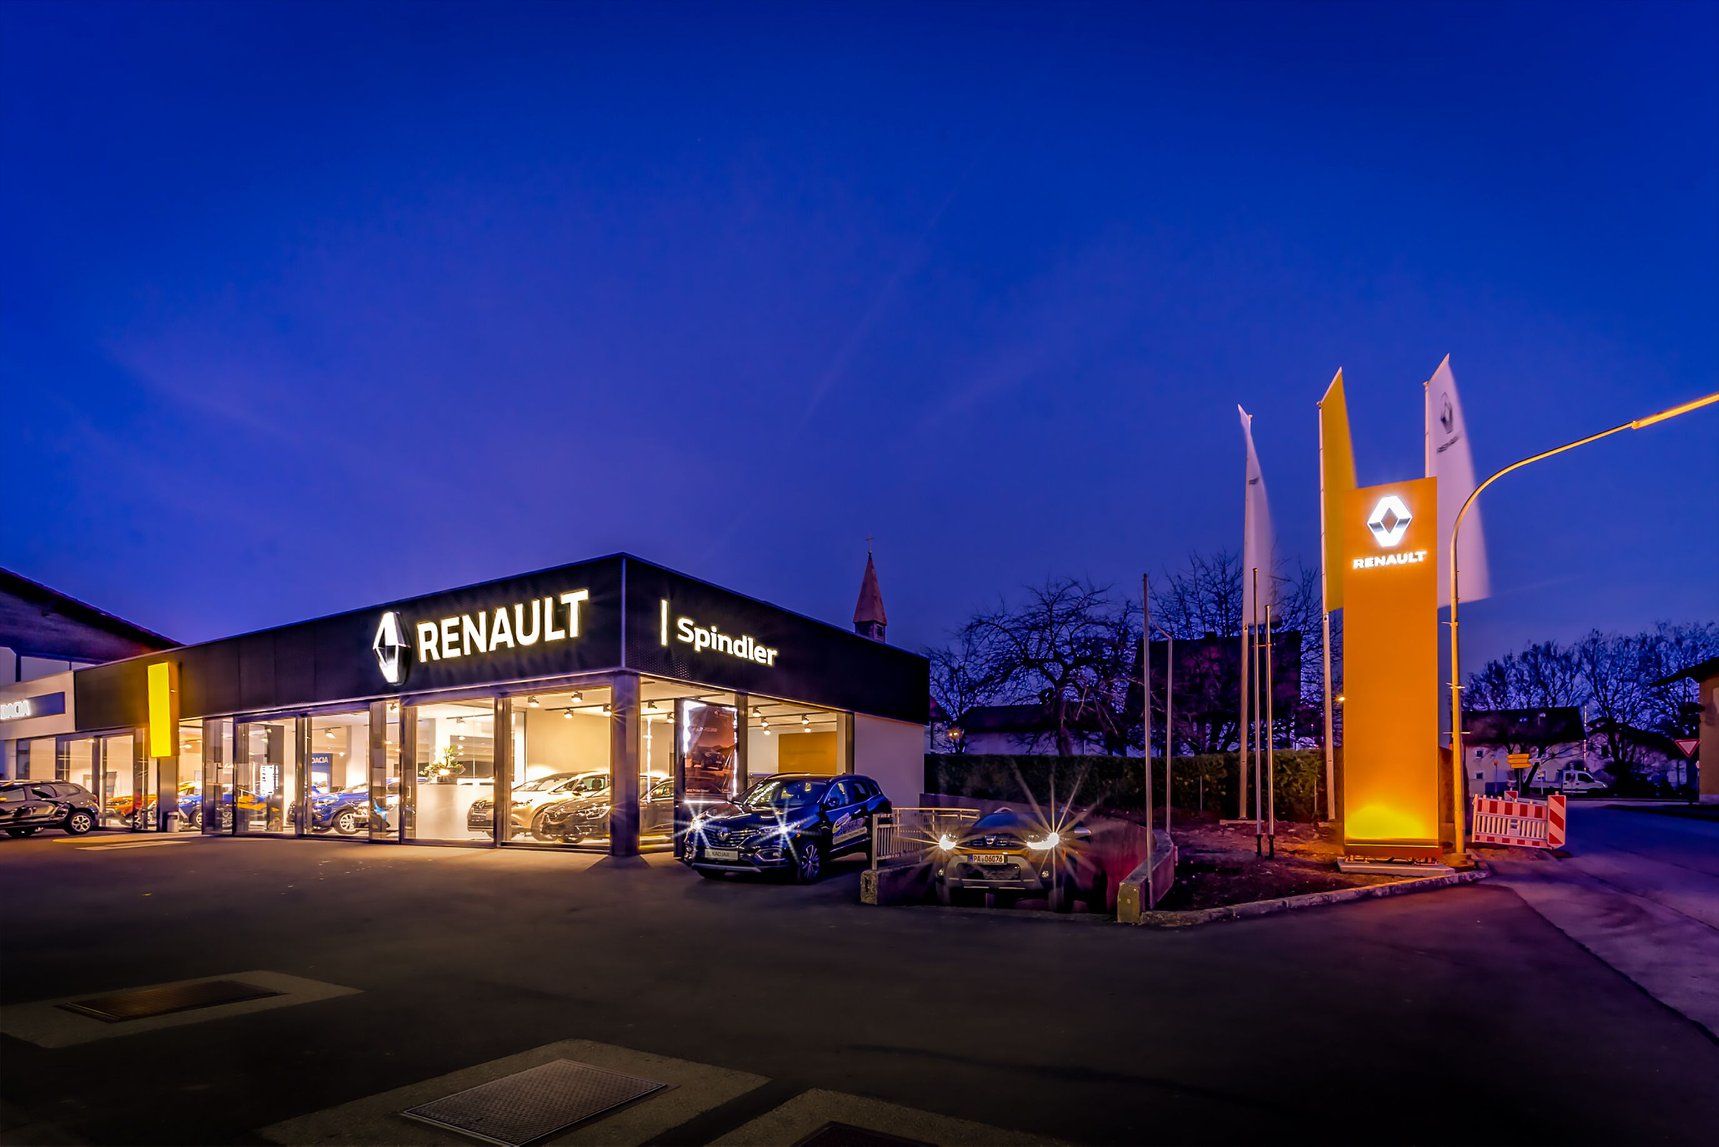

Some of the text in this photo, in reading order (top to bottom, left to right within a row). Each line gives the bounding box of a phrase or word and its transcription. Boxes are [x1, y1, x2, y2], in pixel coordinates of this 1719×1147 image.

[1352, 550, 1427, 570] RENAULT
[416, 588, 589, 663] RENAULT
[677, 617, 778, 667] Spindler
[0, 699, 31, 720] DACIA
